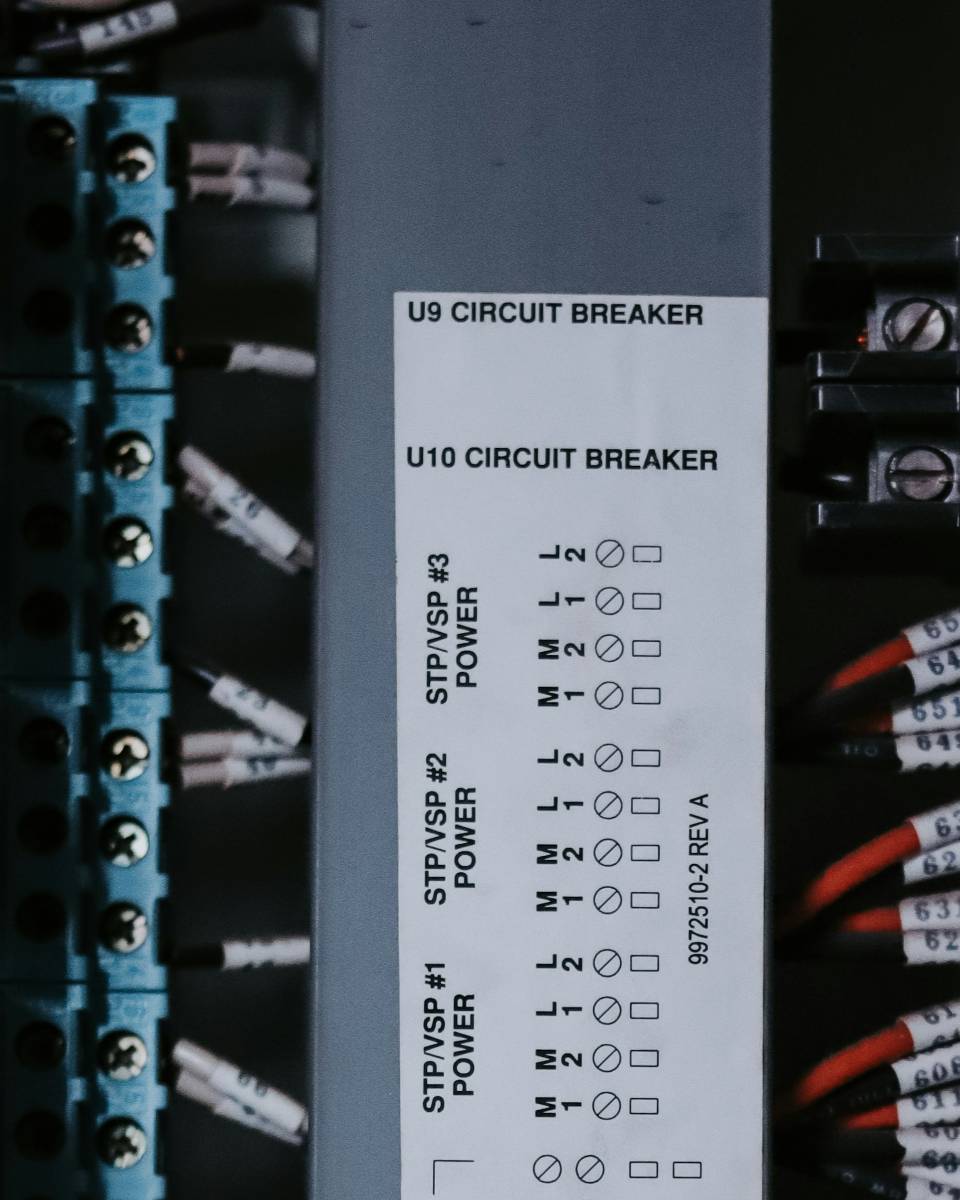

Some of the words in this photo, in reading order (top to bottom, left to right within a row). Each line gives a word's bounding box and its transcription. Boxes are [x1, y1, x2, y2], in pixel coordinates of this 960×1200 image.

[409, 302, 441, 322] U9
[452, 302, 562, 323] CIRCUIT
[572, 303, 702, 325] BREAKER
[407, 447, 455, 468] U10
[465, 447, 576, 468] CIRCUIT
[586, 449, 717, 470] BREAKER
[539, 545, 559, 559] L
[565, 548, 585, 561] 2
[428, 554, 448, 583] #3
[539, 592, 559, 606] L
[565, 597, 585, 605] 1
[426, 591, 448, 704] STP/VSP
[456, 587, 477, 687] POWER
[538, 639, 559, 659] M
[564, 643, 584, 656] 2
[538, 687, 558, 706] M
[564, 692, 584, 700] 1
[538, 749, 558, 763] L
[563, 753, 583, 766] 2
[426, 754, 447, 783] #2
[537, 797, 558, 811] L
[563, 802, 583, 810] 1
[690, 794, 708, 808] A
[455, 788, 476, 888] POWER
[689, 818, 708, 855] REV
[424, 791, 446, 905] STP/VSP
[537, 844, 557, 864] M
[562, 848, 583, 861] 2
[537, 892, 557, 911] M
[563, 897, 583, 905] 1
[688, 864, 708, 964] 9972510-2
[536, 954, 557, 968] L
[562, 958, 582, 971] 2
[425, 964, 445, 989] #1
[536, 1002, 556, 1016] L
[562, 1007, 582, 1015] 1
[423, 998, 445, 1112] STP/VSP
[453, 994, 474, 1095] POWER
[536, 1049, 556, 1069] M
[561, 1053, 582, 1067] 2
[535, 1097, 556, 1117] M
[561, 1102, 581, 1111] 1
